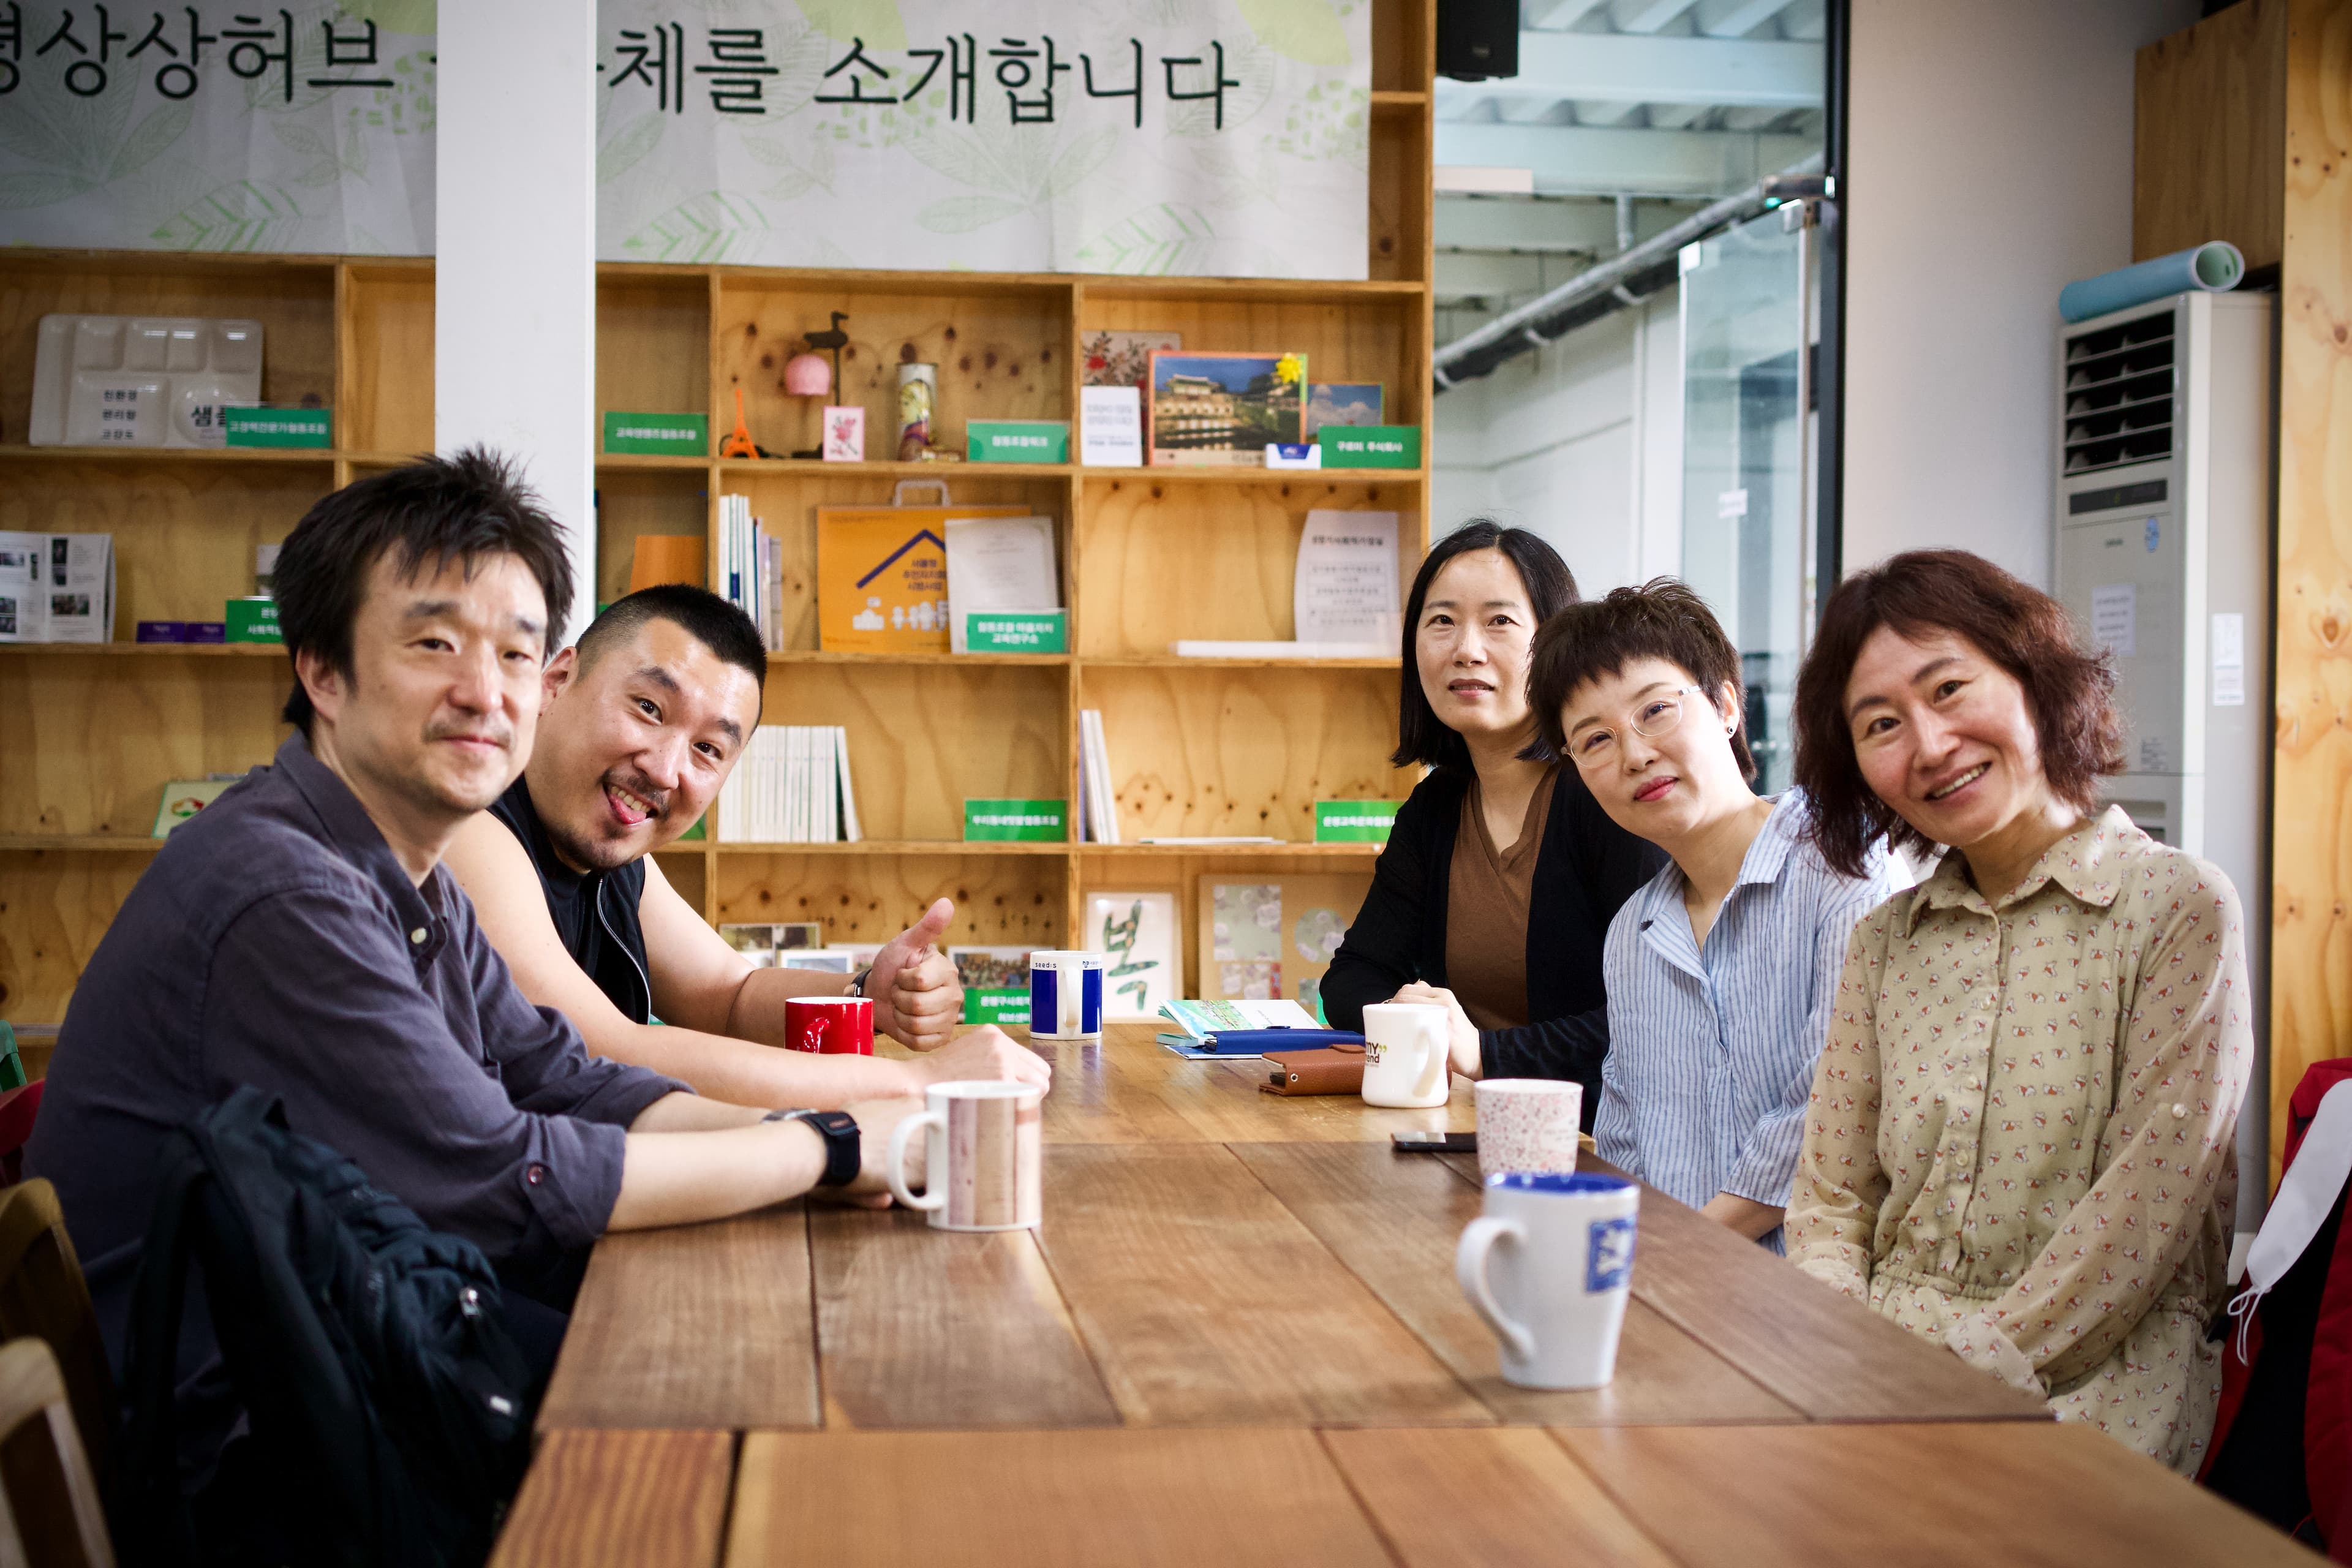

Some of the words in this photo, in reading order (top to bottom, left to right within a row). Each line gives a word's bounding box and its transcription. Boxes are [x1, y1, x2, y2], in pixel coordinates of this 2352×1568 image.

[0, 2, 394, 102] 상상허브
[597, 22, 779, 115] 체를
[814, 33, 1240, 130] 소개합니다
[1103, 899, 1159, 1011] 복
